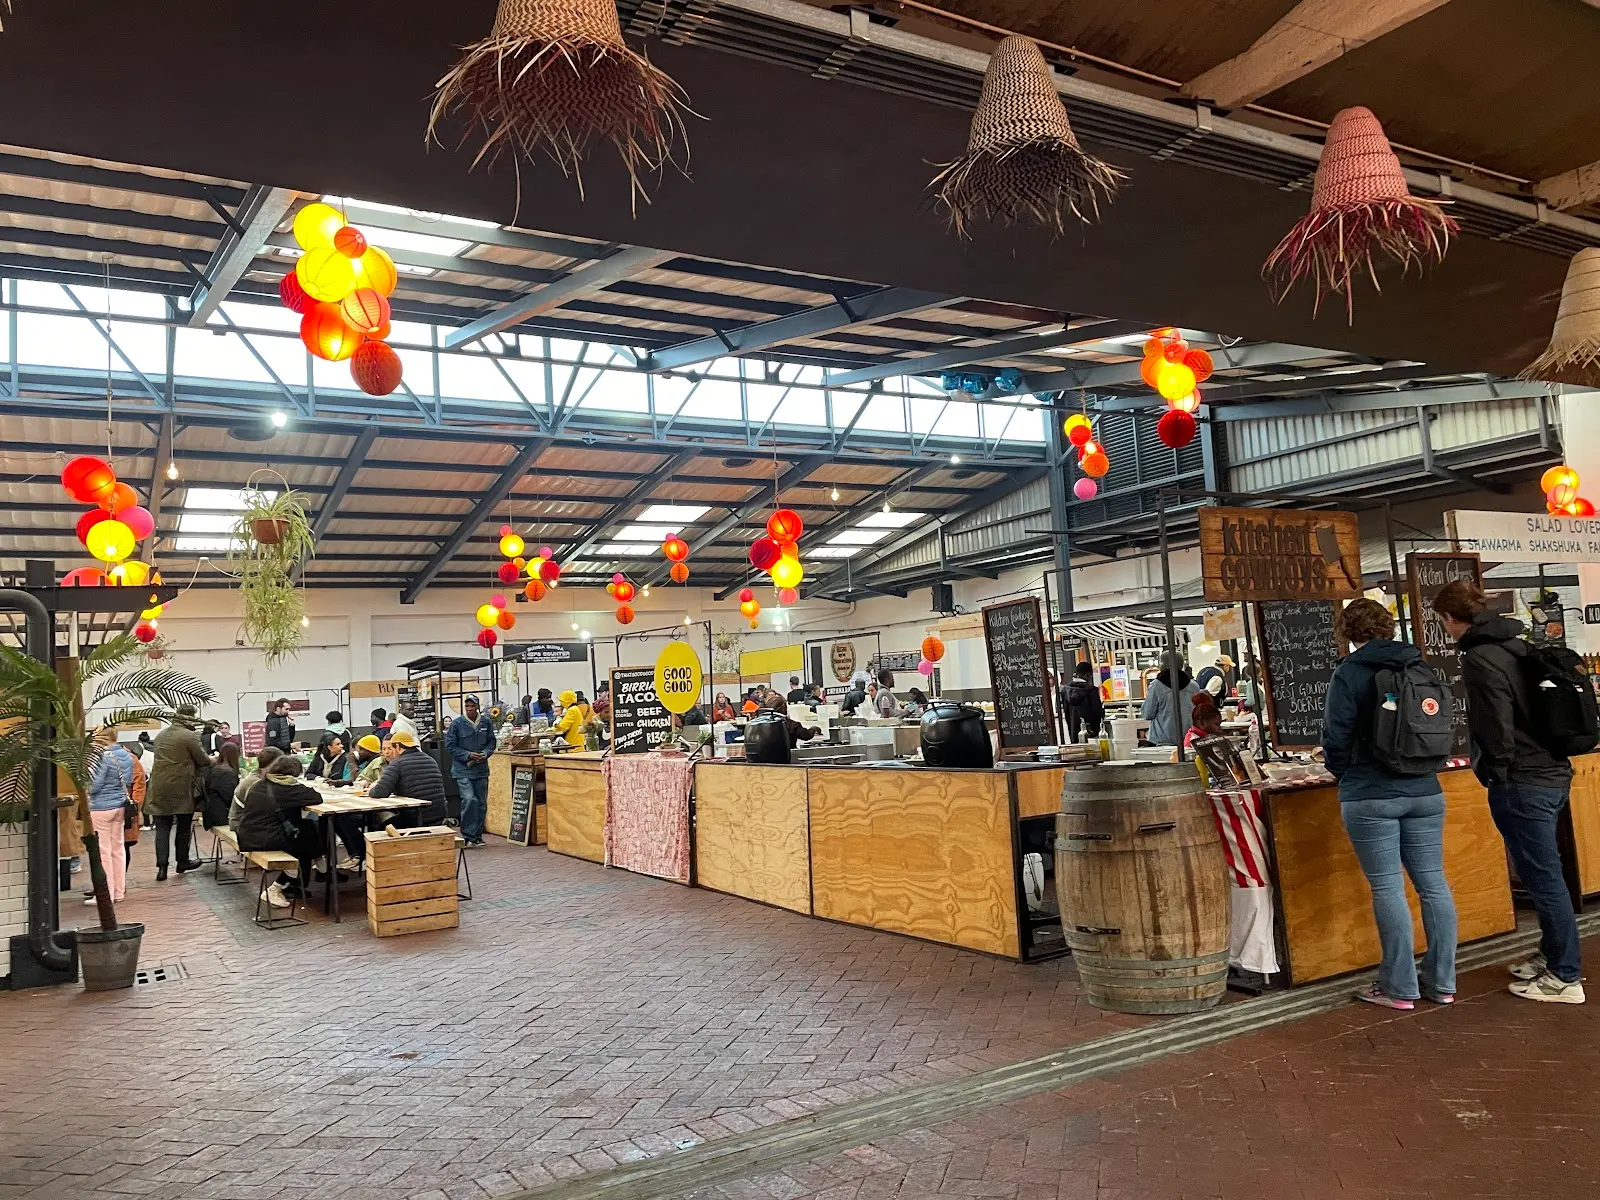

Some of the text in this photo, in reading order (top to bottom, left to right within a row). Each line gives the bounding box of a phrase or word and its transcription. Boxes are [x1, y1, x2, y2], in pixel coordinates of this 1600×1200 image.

[1527, 518, 1562, 533] SALAD
[1222, 516, 1310, 555] kitchen
[1468, 538, 1522, 552] SHAWARMA
[1529, 540, 1582, 553] SHAKSHUKA
[663, 667, 692, 681] GOOD
[663, 680, 693, 693] GOOD
[636, 706, 663, 717] BEEF
[1289, 696, 1325, 714] BOERIE
[636, 715, 671, 728] CHICKEN
